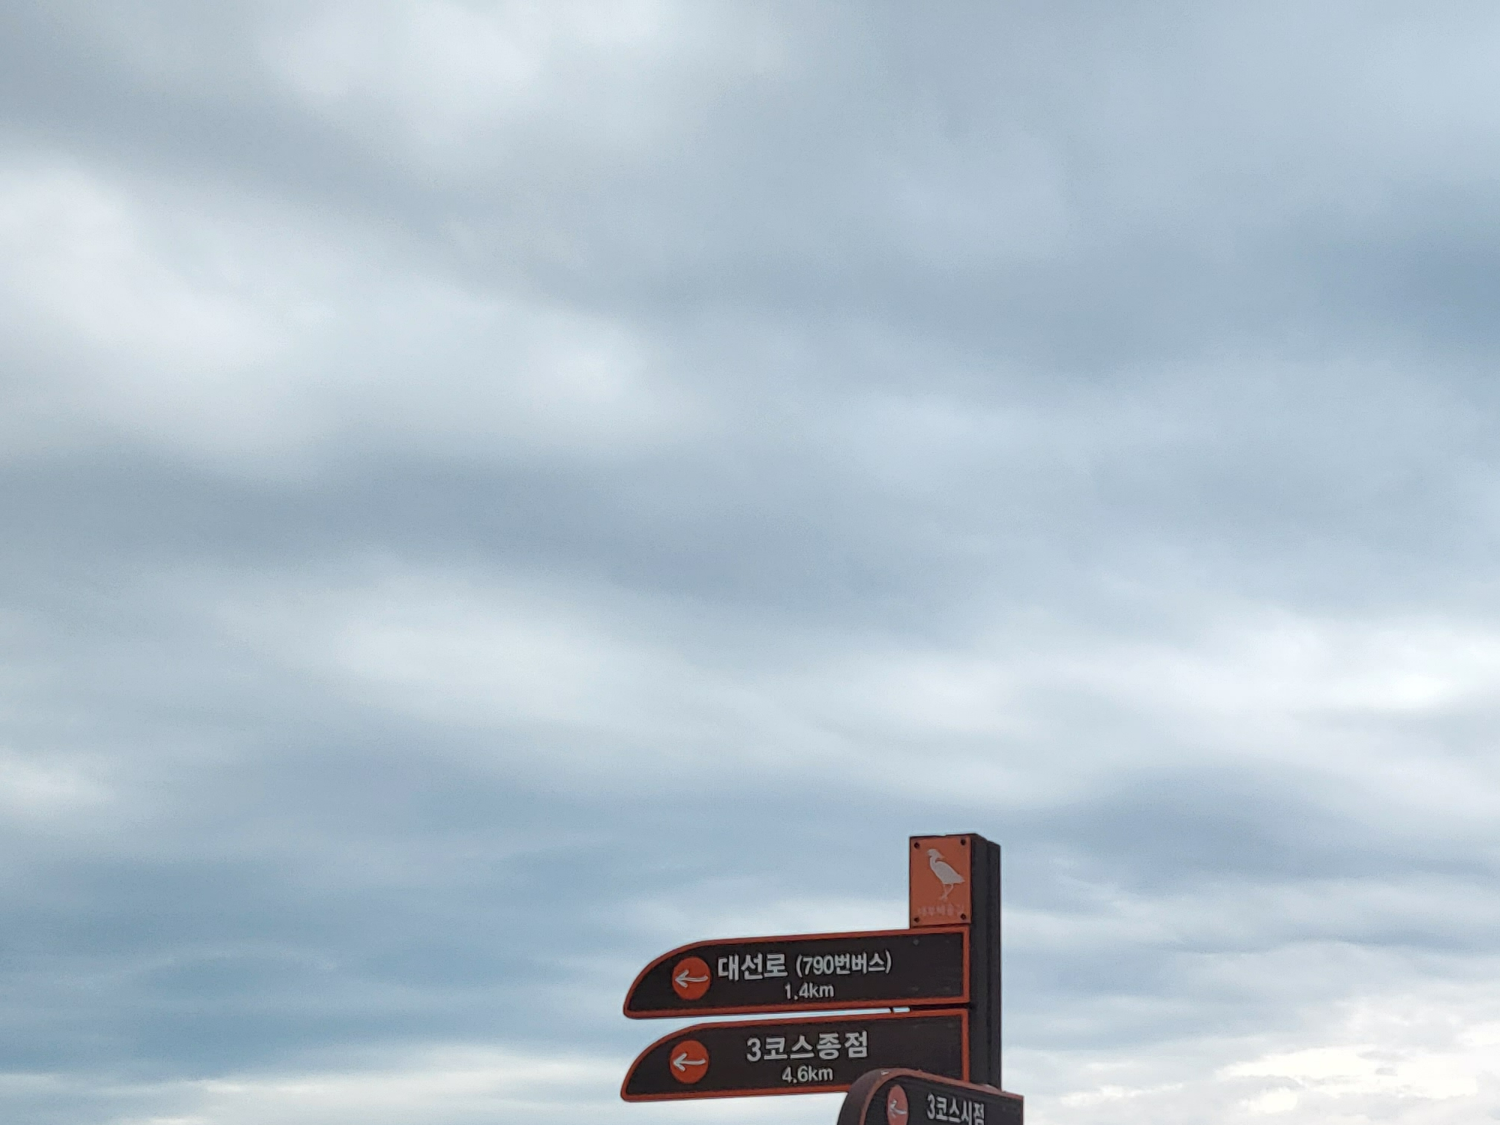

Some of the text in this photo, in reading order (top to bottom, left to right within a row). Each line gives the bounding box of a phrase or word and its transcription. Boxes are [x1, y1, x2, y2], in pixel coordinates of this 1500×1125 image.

[717, 950, 892, 981] 대선로 (790번버스)
[784, 982, 835, 1000] 1.4km
[746, 1030, 868, 1062] 3코스종점
[781, 1065, 834, 1084] 4.6km
